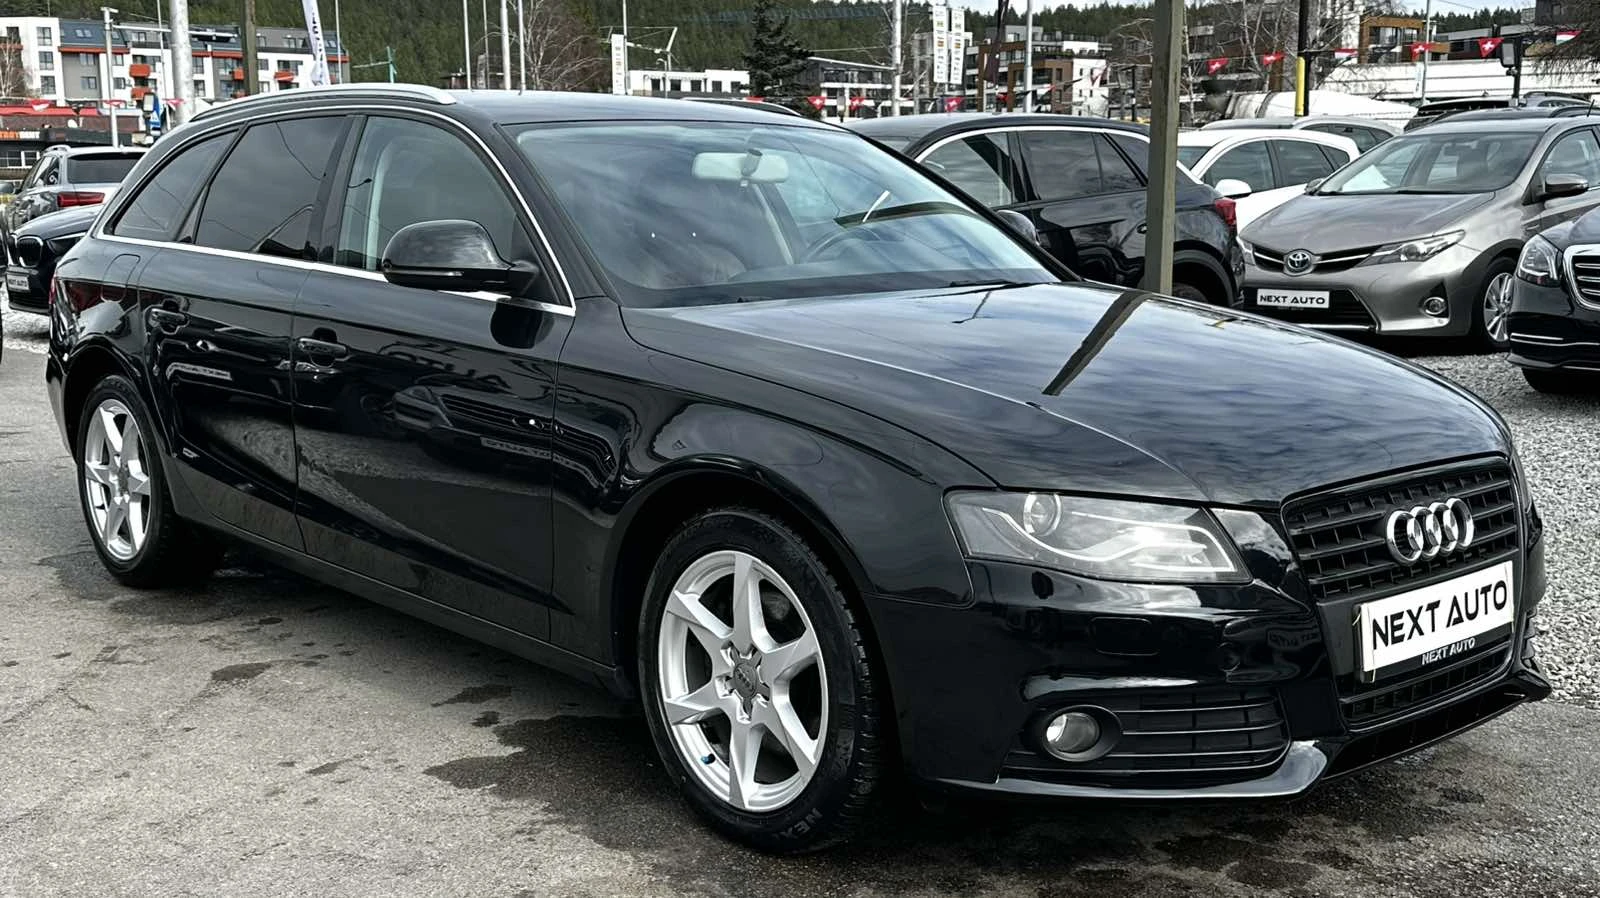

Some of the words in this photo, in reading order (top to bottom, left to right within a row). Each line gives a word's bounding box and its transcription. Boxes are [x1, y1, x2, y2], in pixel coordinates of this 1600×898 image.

[1260, 295, 1288, 303] NEXT
[1291, 296, 1325, 304] AUTO
[1372, 599, 1441, 650] NEXT
[1446, 580, 1507, 628] AUTO
[1421, 647, 1448, 666] NEXT
[1449, 637, 1476, 657] AUTO
